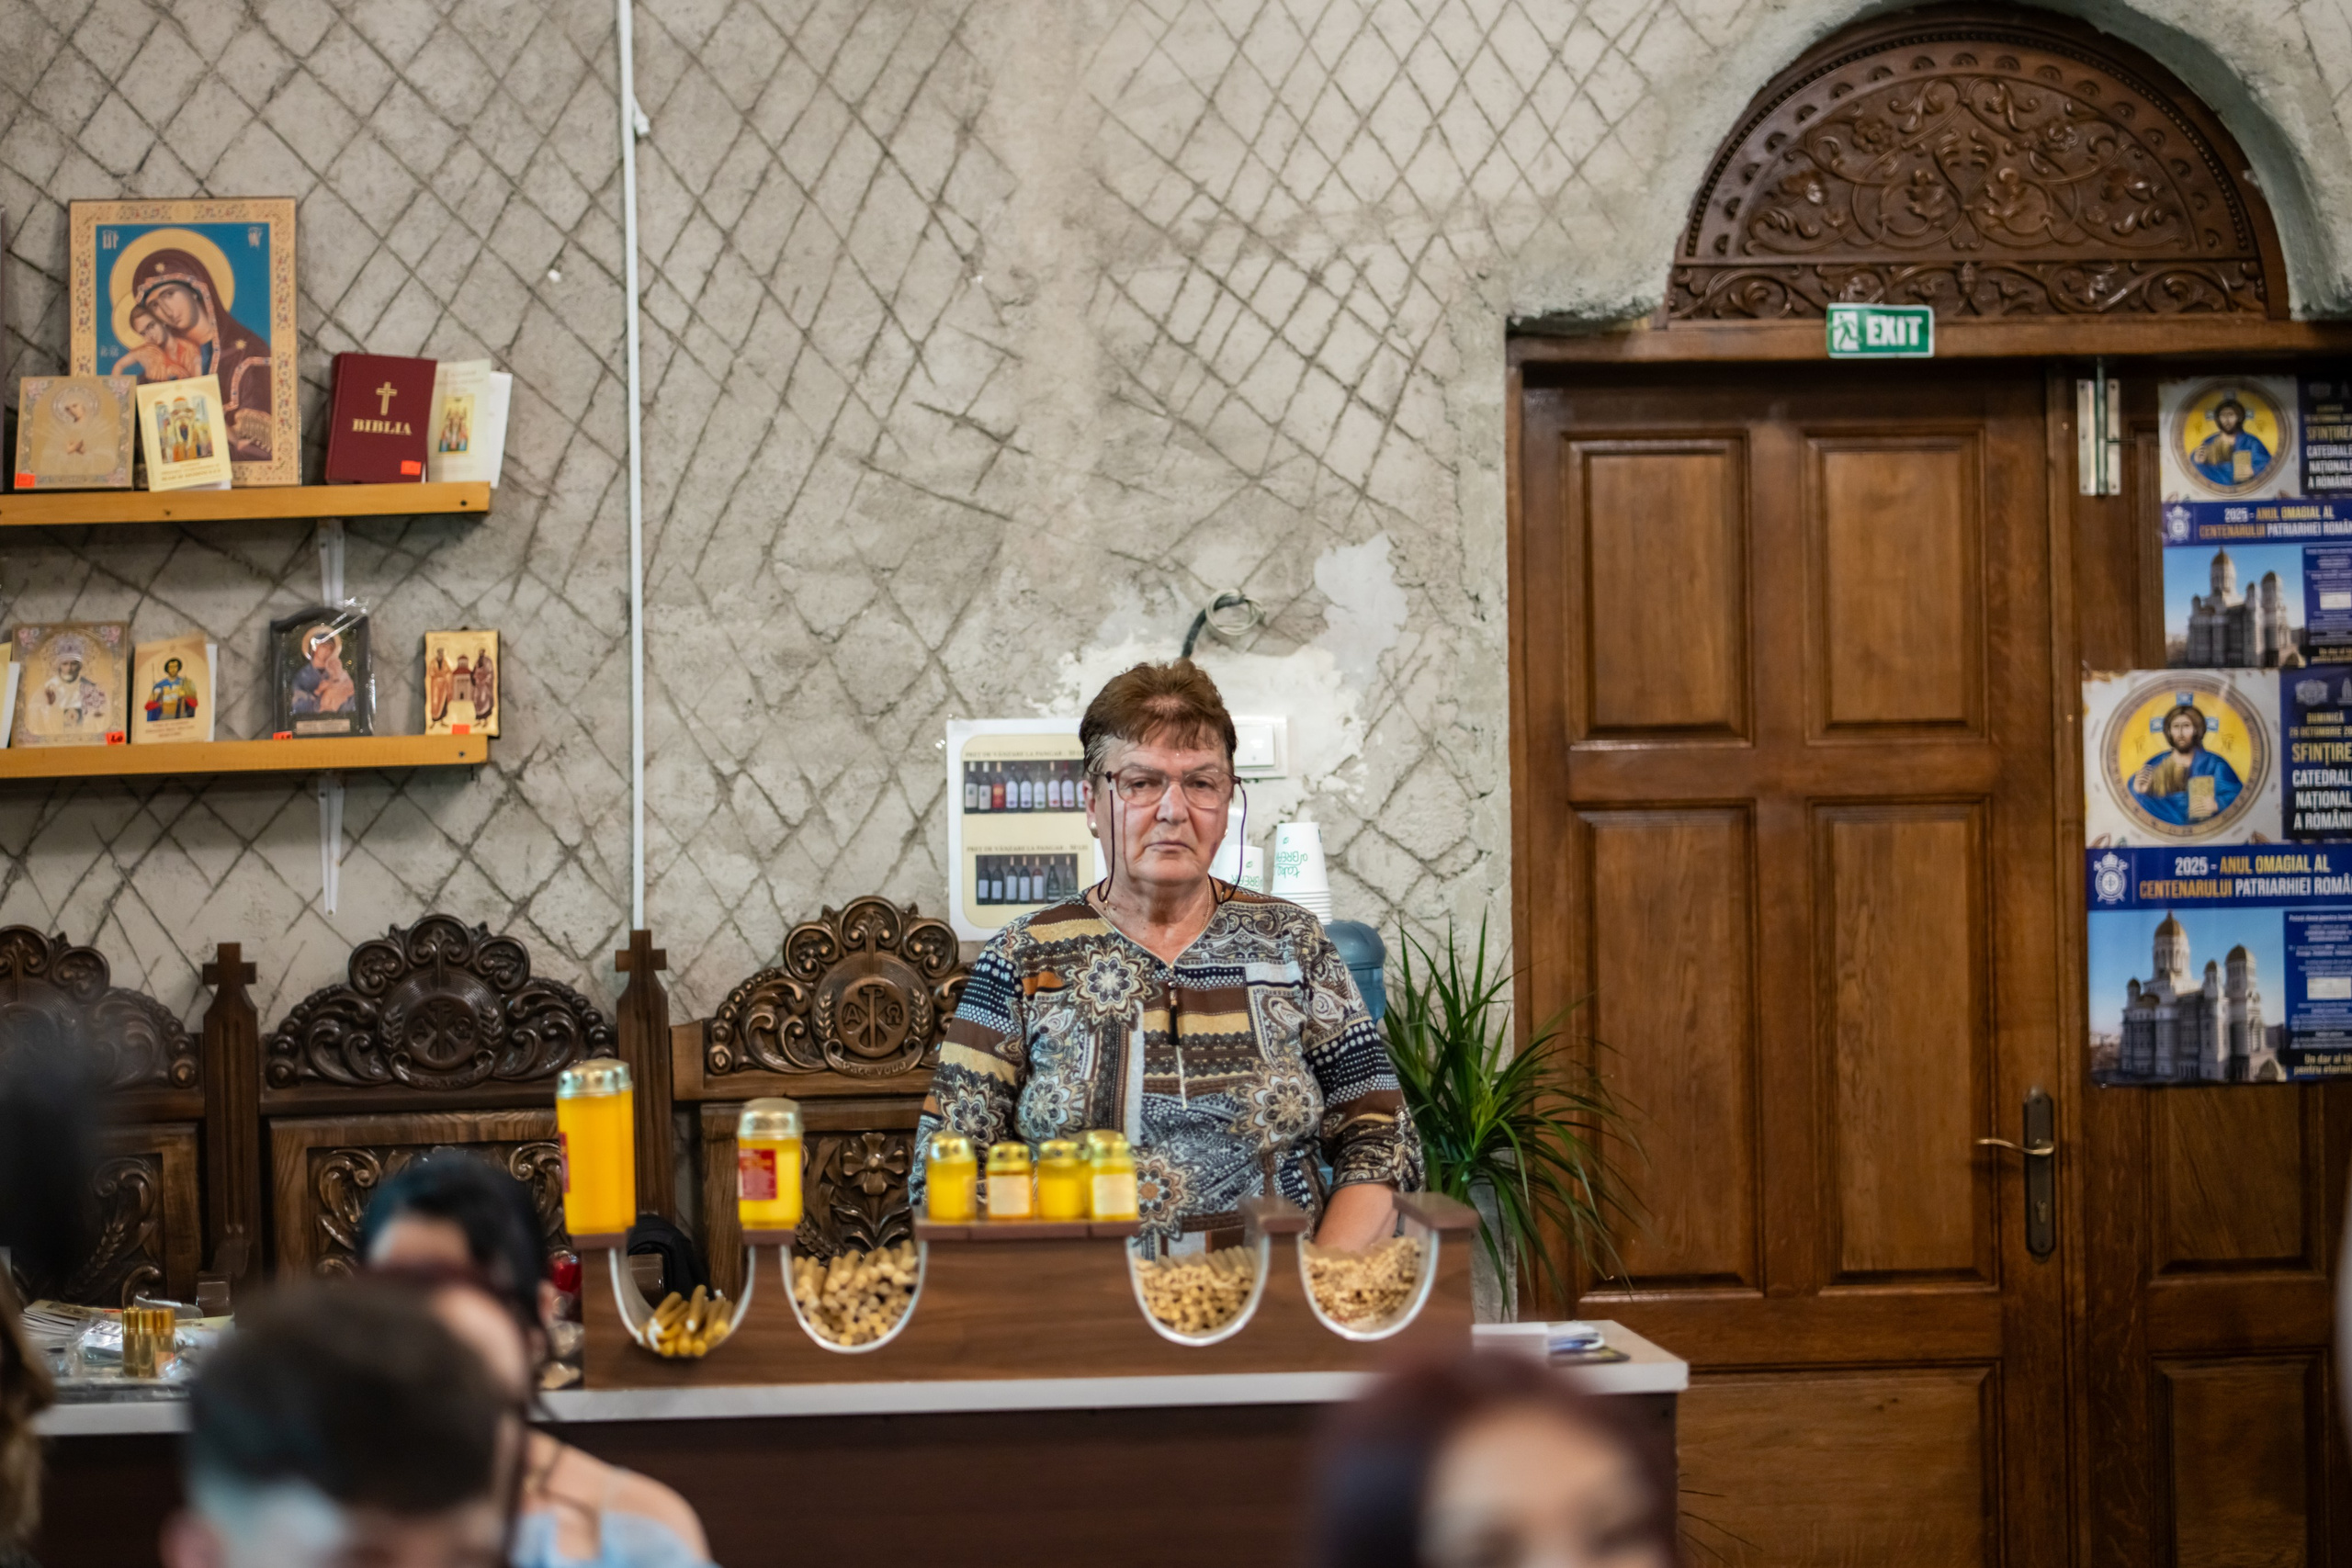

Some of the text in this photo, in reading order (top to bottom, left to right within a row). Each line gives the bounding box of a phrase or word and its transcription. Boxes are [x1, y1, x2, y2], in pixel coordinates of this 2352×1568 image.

[1866, 314, 1923, 346] EXIT
[352, 417, 413, 436] BIBLIA
[2224, 507, 2248, 523] 2025
[2256, 507, 2278, 521] ANUL
[2280, 506, 2321, 520] OMAGIAL
[2323, 505, 2335, 520] AL
[2199, 523, 2266, 539] CENTENARULUI
[2267, 521, 2322, 537] PATRIARHIEI
[2292, 769, 2352, 787] CATEDRAL
[2293, 808, 2352, 830] A ROMÂNI
[2175, 856, 2208, 876] 2025
[2219, 856, 2253, 874] ANUL
[2255, 855, 2312, 874] OMAGIAL
[2314, 854, 2331, 873] AL
[2140, 873, 2352, 899] CENTENARULUI PATRIARHIEI ROMÂ
